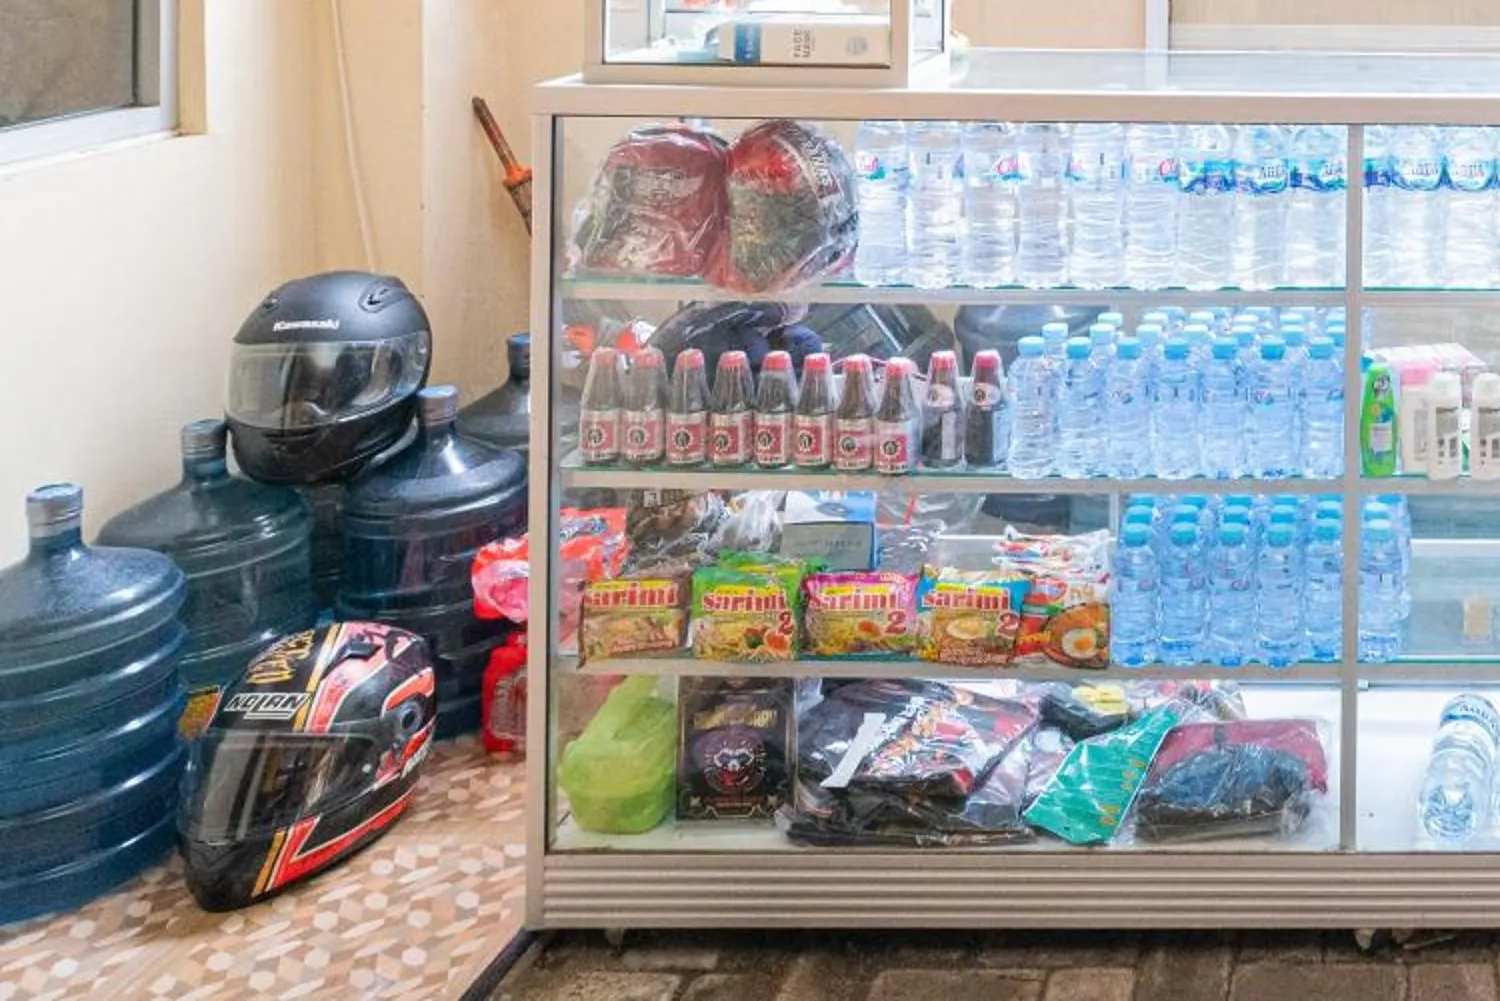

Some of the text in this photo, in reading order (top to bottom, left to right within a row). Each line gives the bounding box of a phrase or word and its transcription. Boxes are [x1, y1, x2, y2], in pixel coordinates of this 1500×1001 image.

[778, 611, 794, 635] 2
[885, 610, 906, 635] 2
[996, 611, 1020, 637] 2
[224, 692, 308, 719] NOLAN
